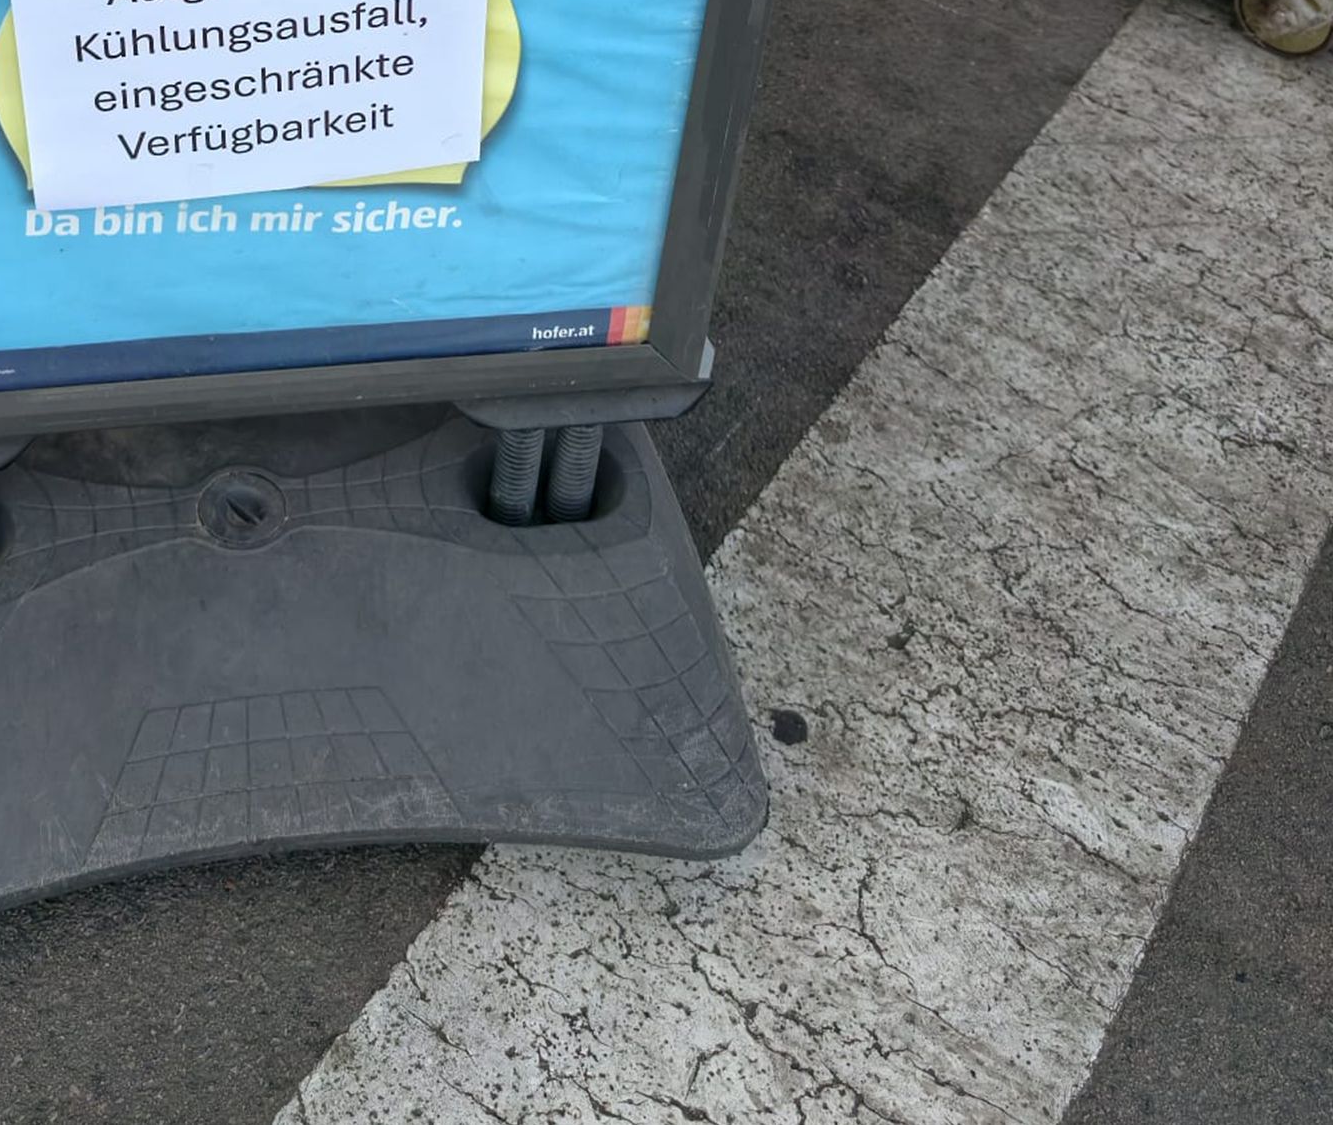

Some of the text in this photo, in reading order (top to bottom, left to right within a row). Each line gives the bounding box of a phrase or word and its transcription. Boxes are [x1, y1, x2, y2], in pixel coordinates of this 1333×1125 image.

[94, 52, 415, 112] eingeschränkte
[117, 103, 395, 161] Verfügbarkeit
[24, 200, 464, 237] Da bin ich mir sicher.
[531, 324, 596, 340] hofer.at
